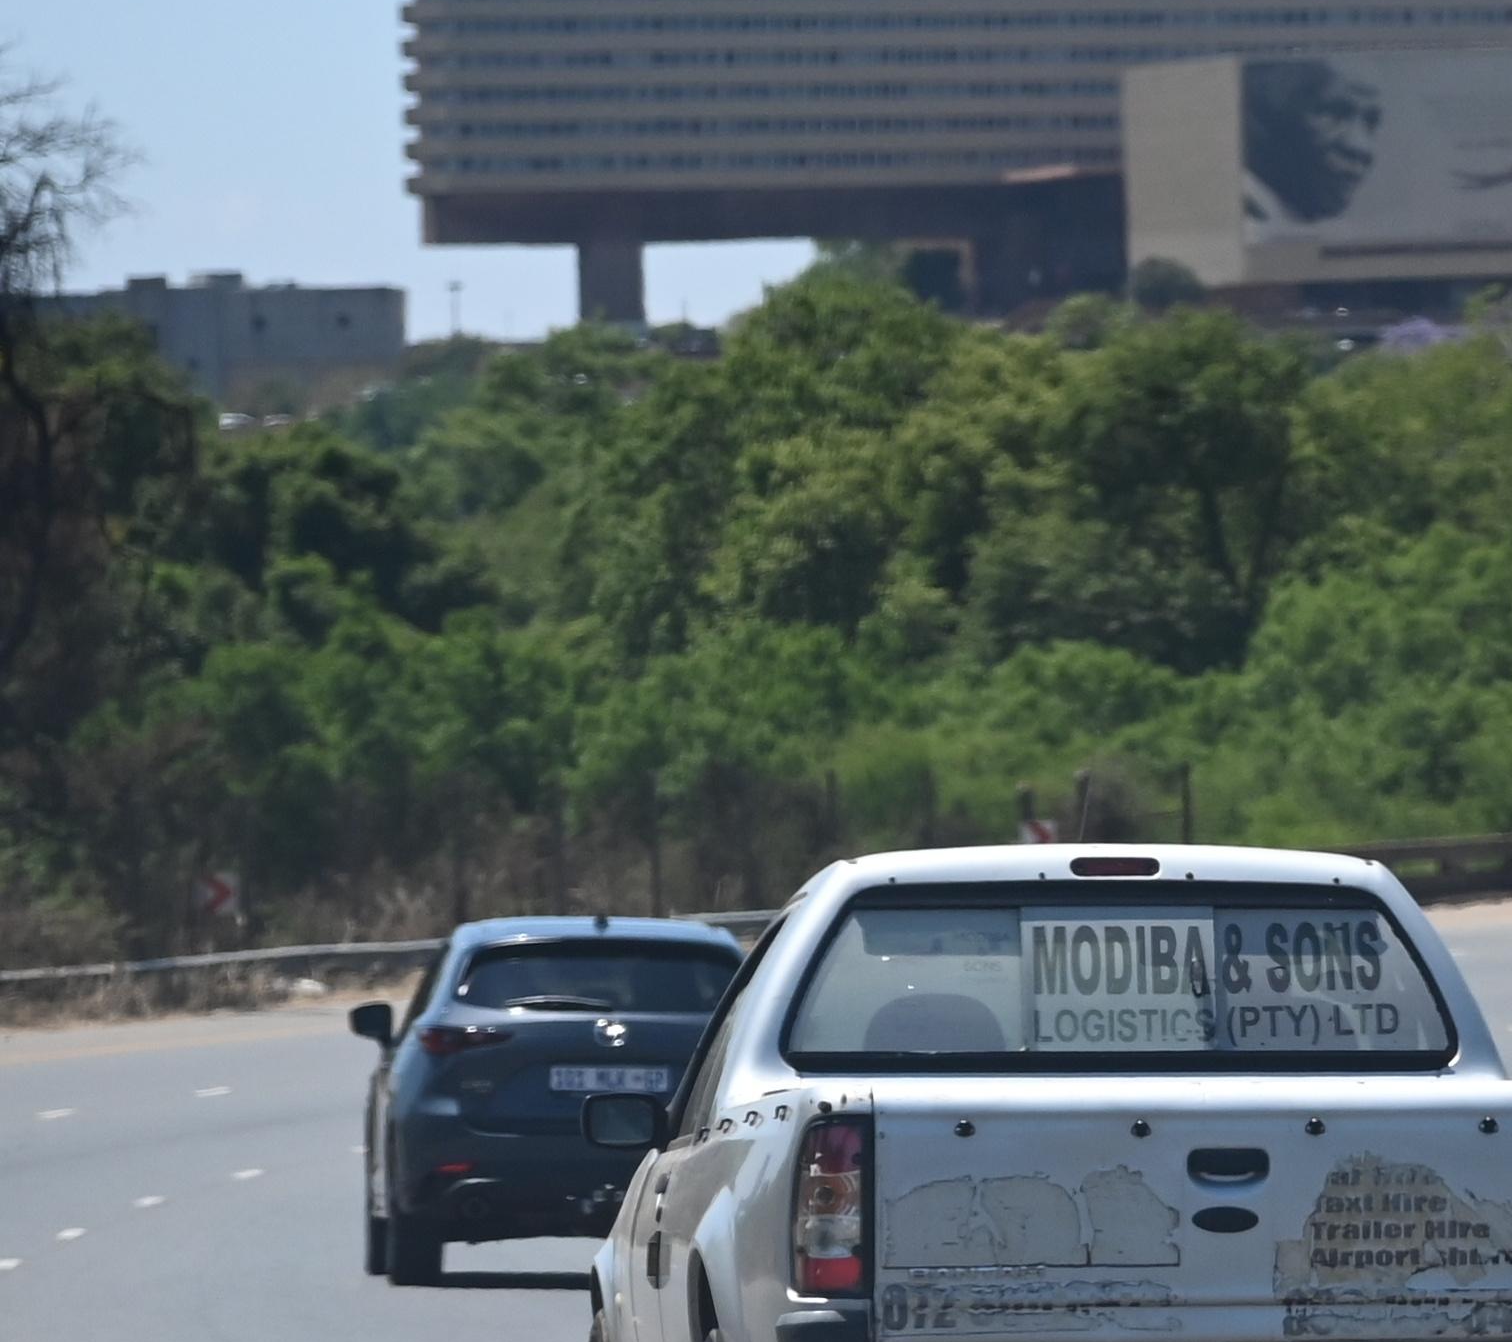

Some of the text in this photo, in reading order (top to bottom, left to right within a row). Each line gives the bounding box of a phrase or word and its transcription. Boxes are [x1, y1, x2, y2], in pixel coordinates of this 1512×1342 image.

[1033, 920, 1383, 996] MODIBA & SONS
[1034, 1003, 1399, 1046] LOGISTICS (PTY) LTD
[1310, 1220, 1490, 1240] Trailer Hire
[1310, 1247, 1420, 1268] Airport
